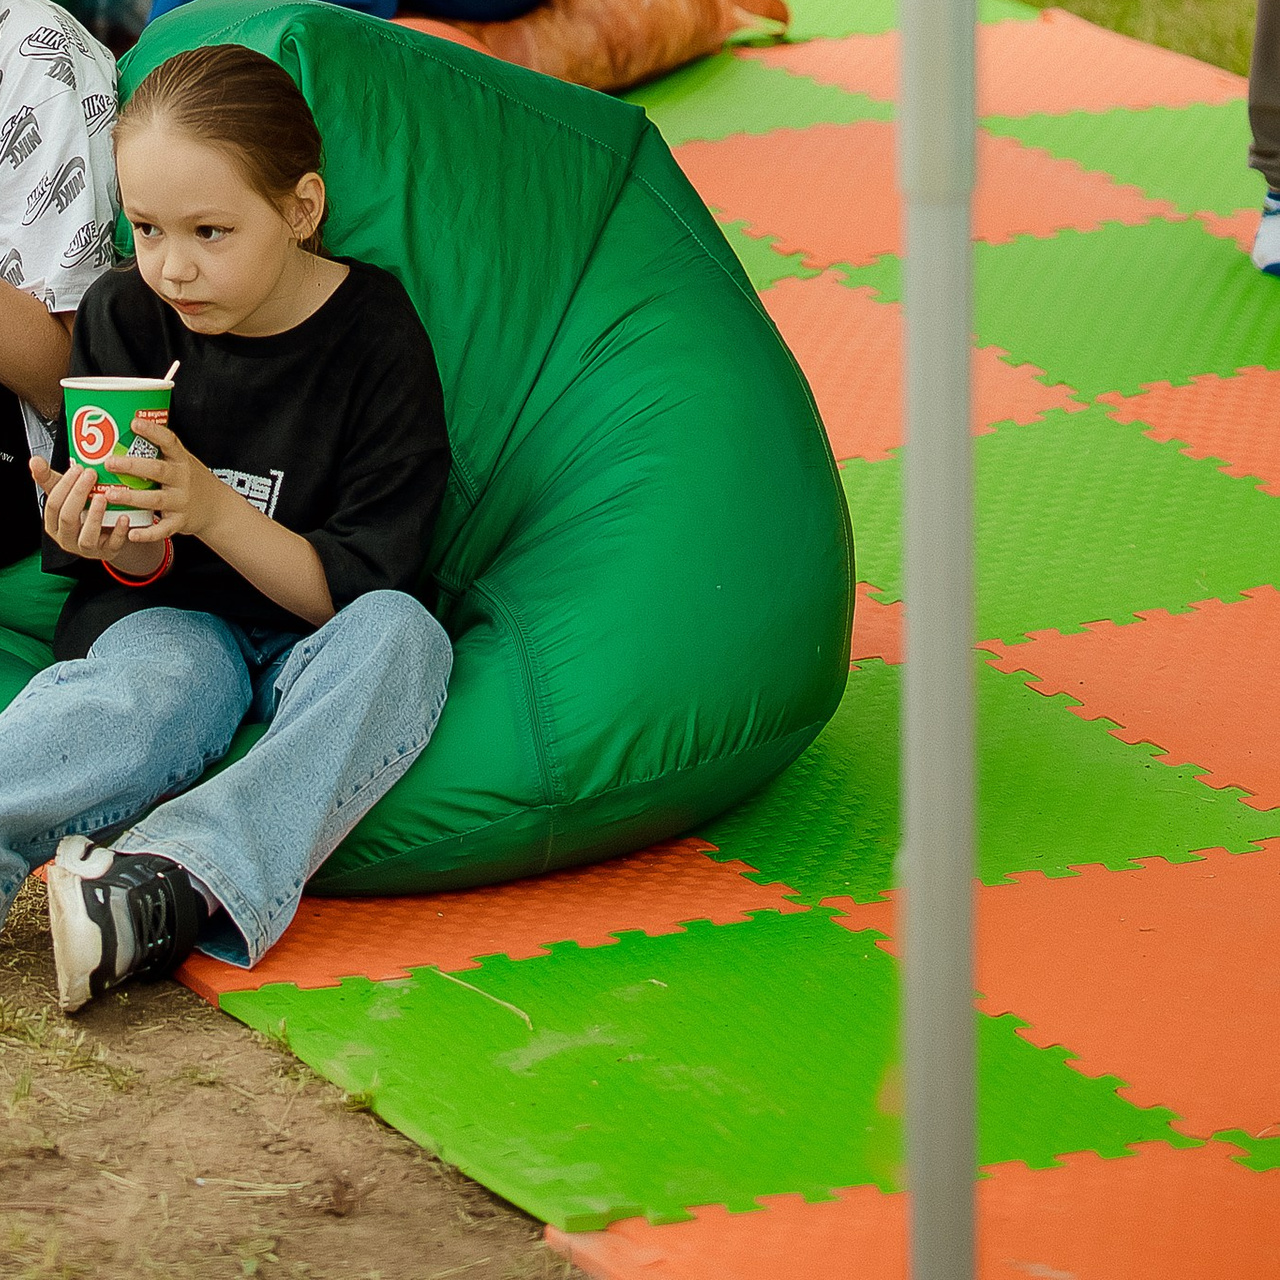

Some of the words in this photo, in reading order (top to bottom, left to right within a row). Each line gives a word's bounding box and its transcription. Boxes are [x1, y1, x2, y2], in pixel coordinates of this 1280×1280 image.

[9, 126, 43, 170] NIKE
[58, 171, 86, 214] NIKE
[80, 410, 106, 455] 5
